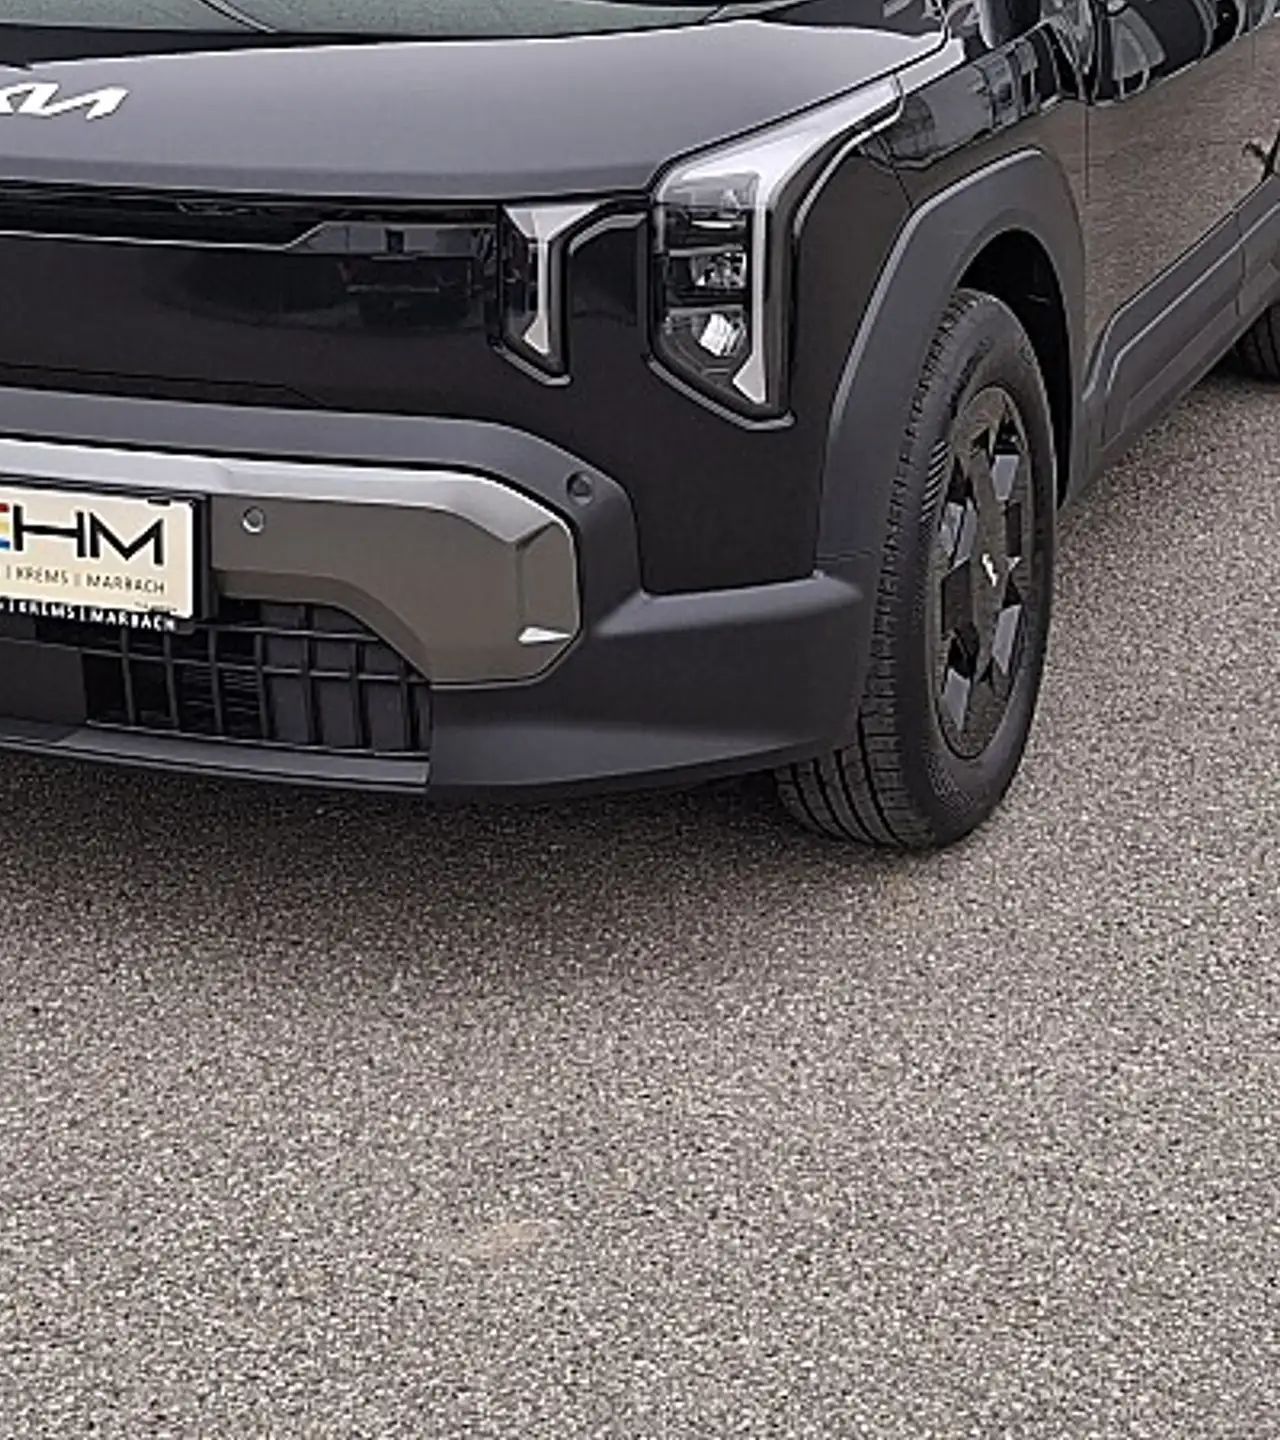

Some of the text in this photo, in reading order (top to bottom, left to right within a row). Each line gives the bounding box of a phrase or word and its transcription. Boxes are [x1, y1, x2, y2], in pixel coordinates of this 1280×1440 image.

[16, 566, 69, 587] KREMS
[86, 573, 166, 596] MARBACH
[90, 607, 176, 632] MARBACH
